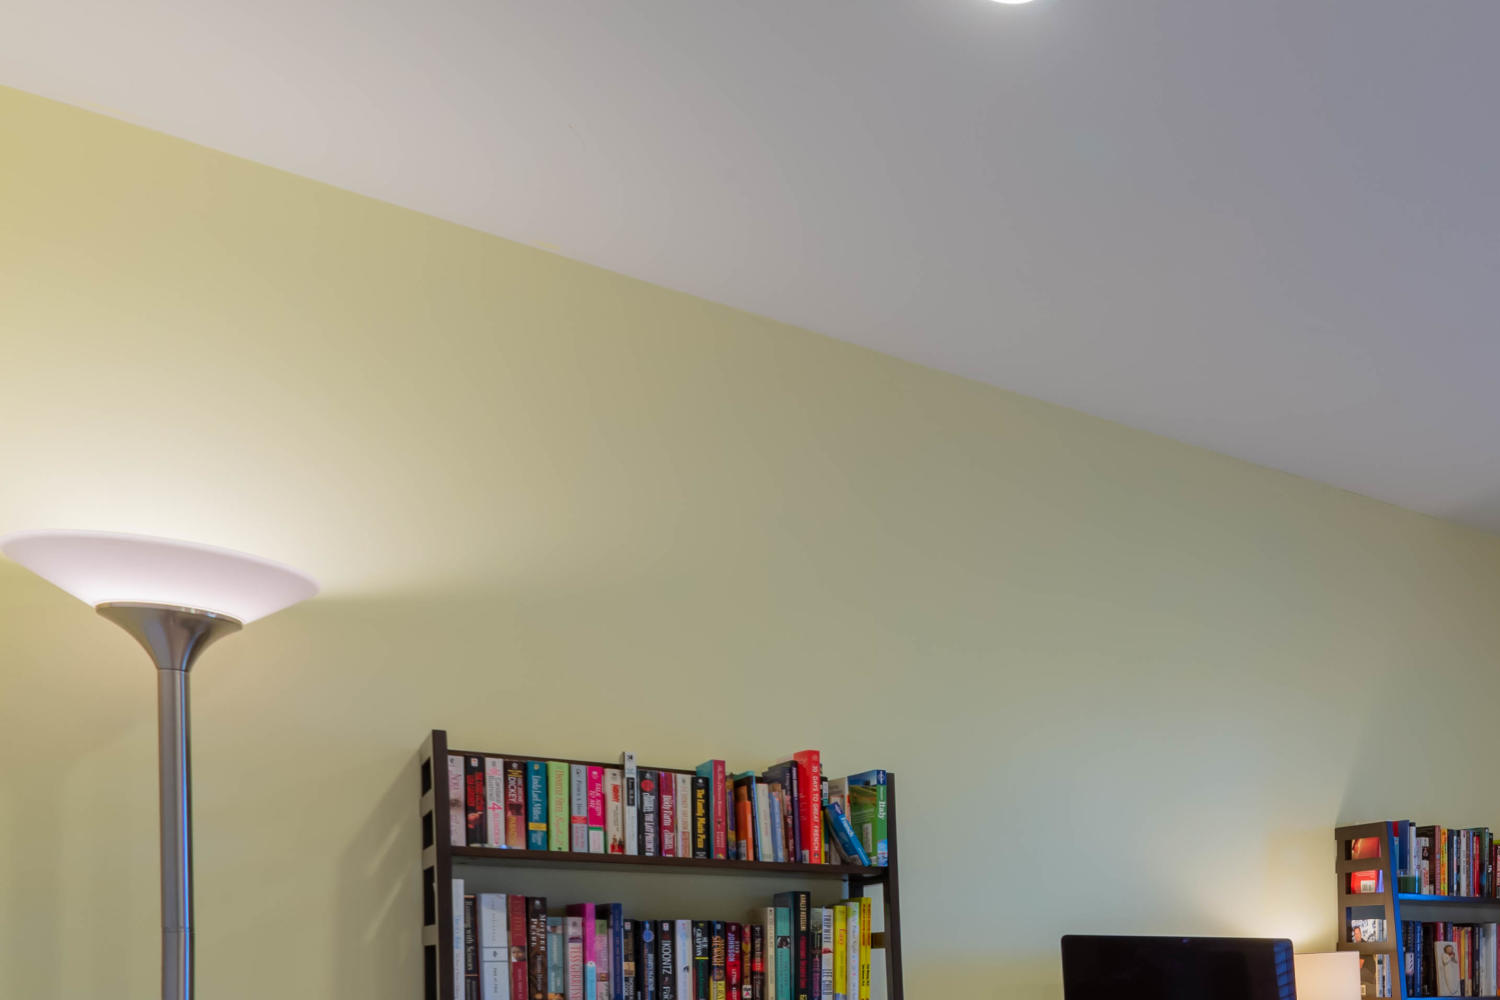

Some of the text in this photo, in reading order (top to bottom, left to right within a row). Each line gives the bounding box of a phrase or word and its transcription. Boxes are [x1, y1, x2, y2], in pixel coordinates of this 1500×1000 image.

[508, 776, 516, 802] DICKEY
[532, 776, 542, 790] Linda
[696, 789, 704, 798] The
[488, 802, 503, 812] 4
[532, 802, 543, 822] Miller
[878, 800, 886, 819] Italy
[696, 817, 706, 834] Mario
[840, 816, 854, 837] French
[697, 834, 706, 848] Puzo
[465, 929, 474, 944] with
[570, 946, 582, 962] TESS
[712, 935, 721, 966] STEWART
[728, 932, 736, 962] JOHNSON
[822, 915, 833, 995] TRIPWIRE LEE CHILD
[662, 942, 672, 974] KOONTZ
